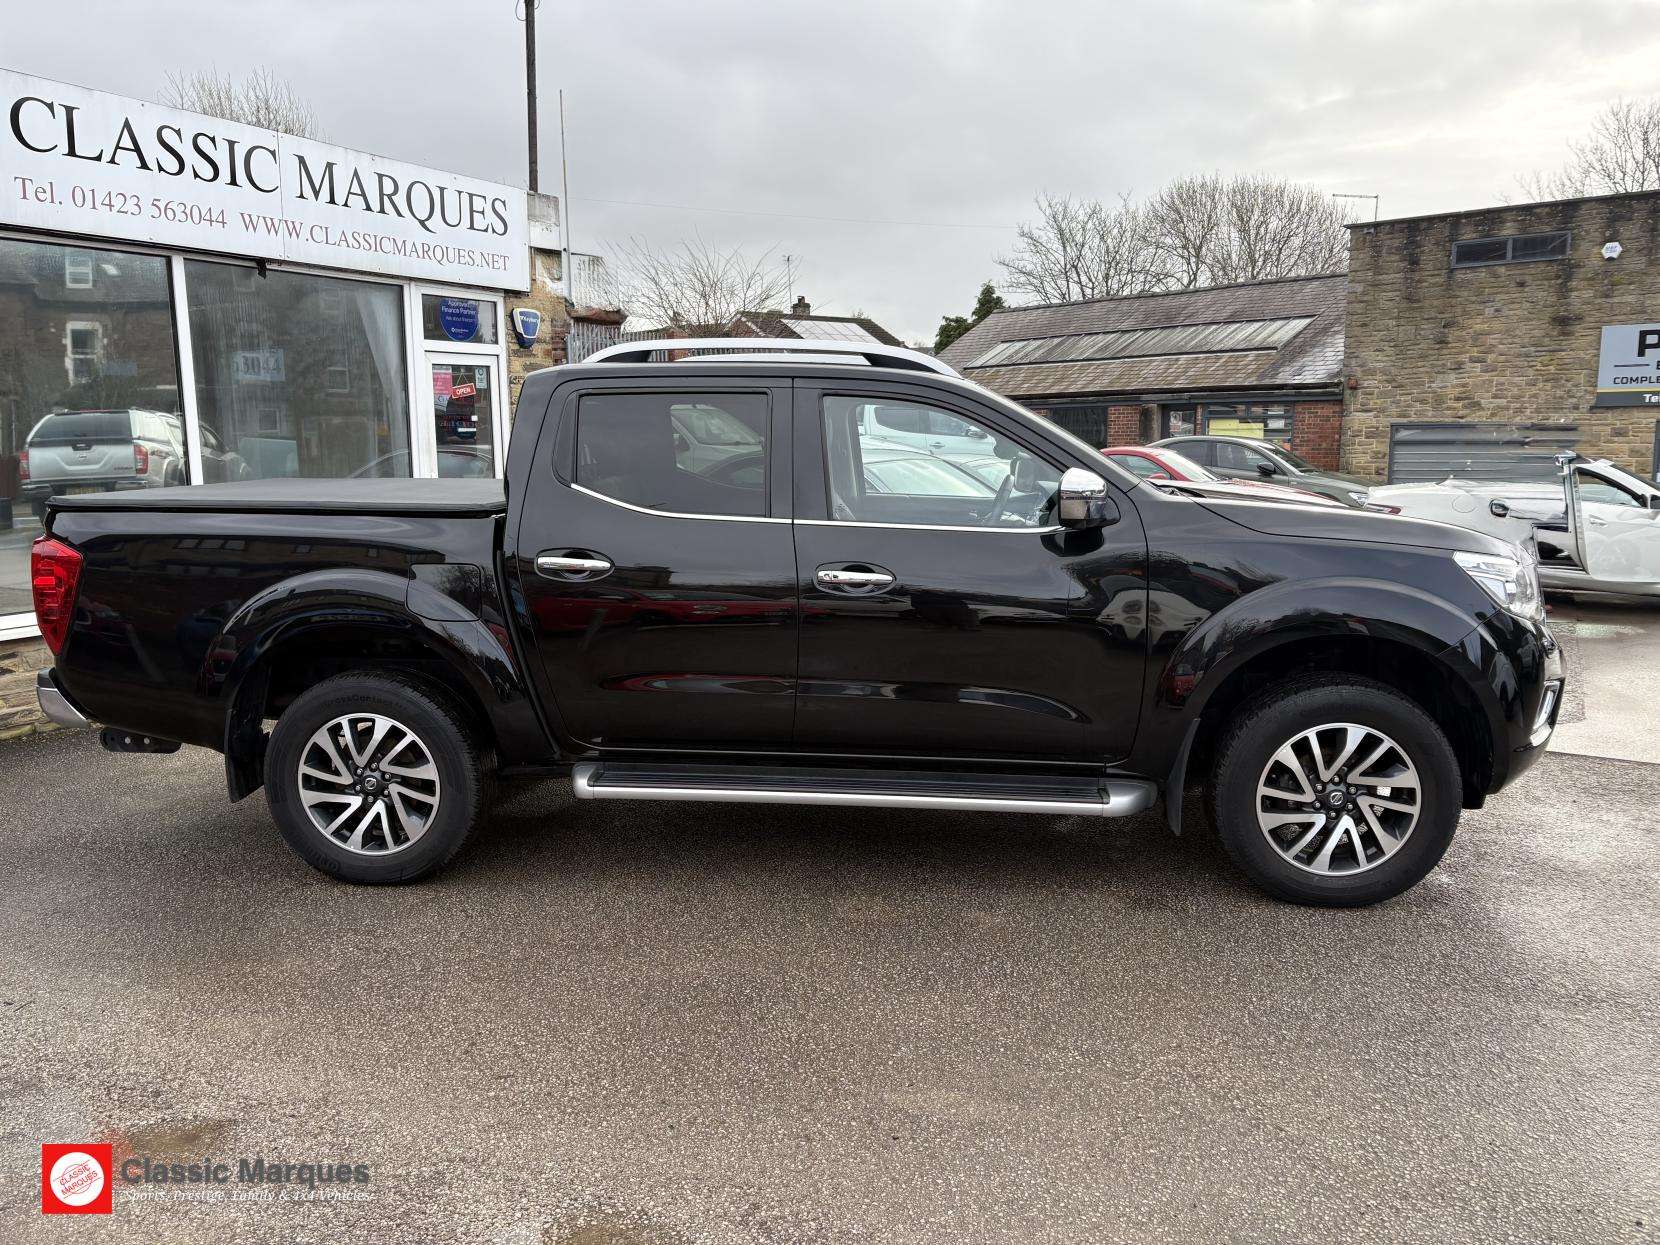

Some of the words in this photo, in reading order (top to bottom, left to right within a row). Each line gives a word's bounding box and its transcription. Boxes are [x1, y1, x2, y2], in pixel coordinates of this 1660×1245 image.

[9, 96, 280, 193] CLASSIC
[293, 154, 510, 236] MARQUES
[14, 176, 63, 205] Tel.
[71, 185, 142, 216] 01423
[150, 198, 228, 228] 563044
[239, 212, 511, 272] WWW.CLASSICMARQUES.NET
[441, 305, 459, 314] Finance
[456, 387, 471, 396] OPEN
